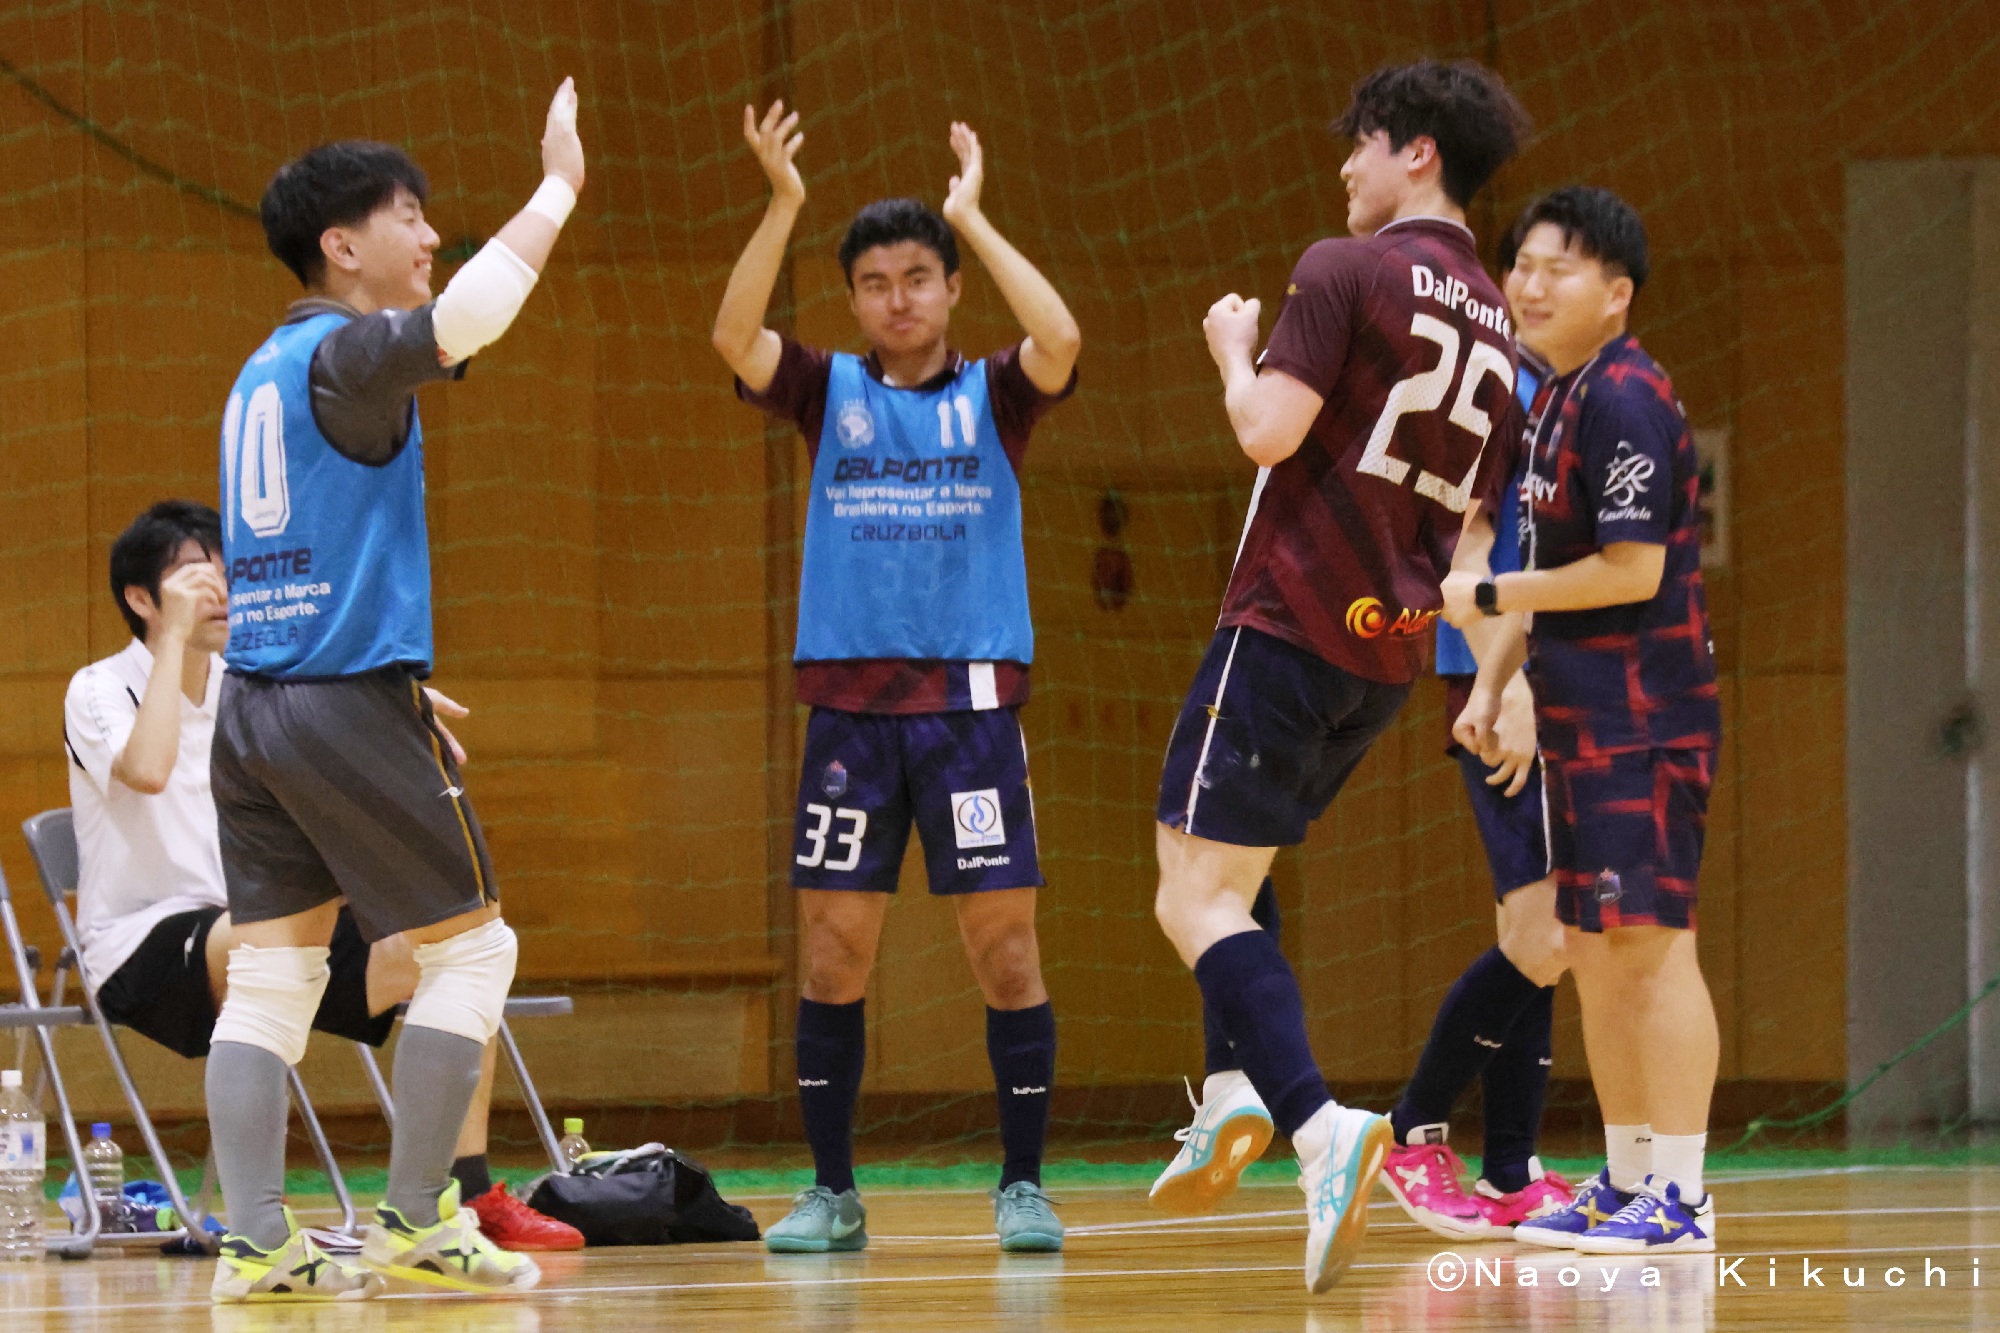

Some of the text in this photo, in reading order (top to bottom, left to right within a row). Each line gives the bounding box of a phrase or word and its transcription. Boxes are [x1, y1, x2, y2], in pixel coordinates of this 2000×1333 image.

[937, 394, 976, 448] 11
[1356, 313, 1514, 513] 25
[224, 381, 290, 543] 10
[902, 505, 922, 517] no
[246, 610, 264, 622] no
[797, 803, 867, 871] 33
[957, 855, 1010, 870] DalPonte
